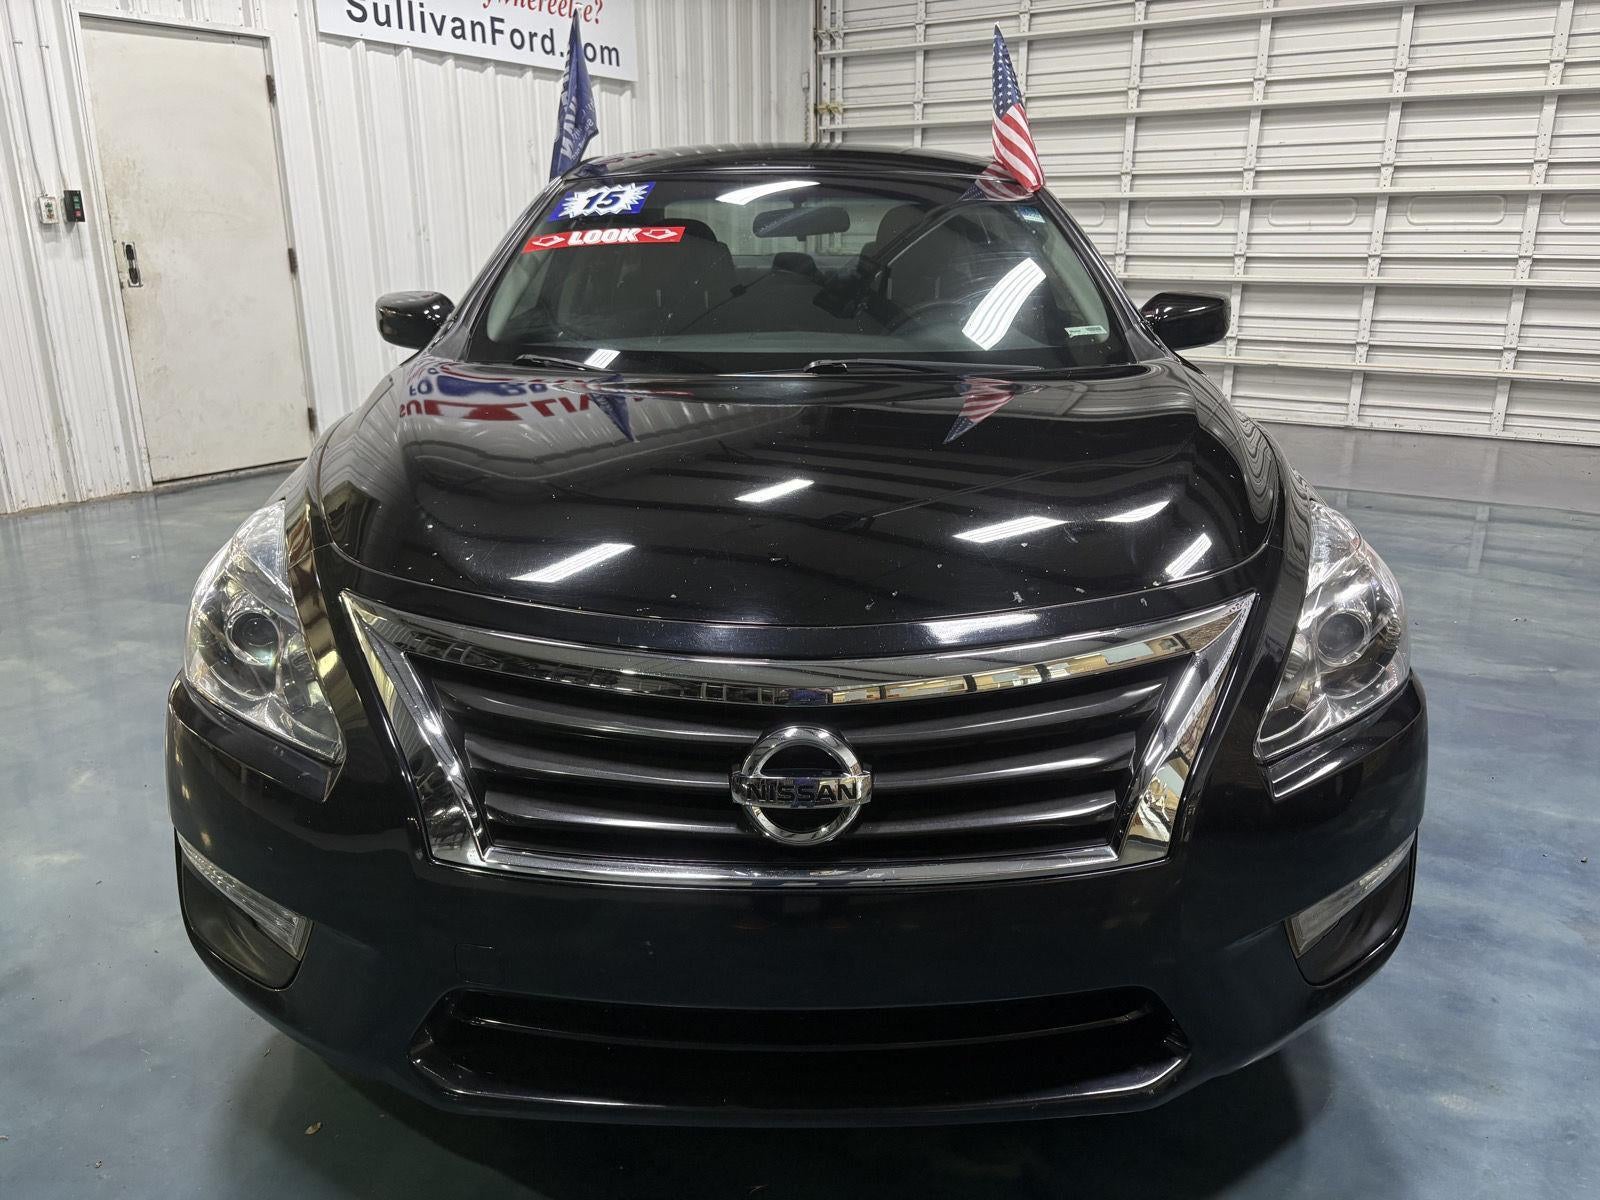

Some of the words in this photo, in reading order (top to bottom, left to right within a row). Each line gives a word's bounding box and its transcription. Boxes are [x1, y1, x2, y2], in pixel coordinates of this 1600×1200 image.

[345, 0, 621, 68] SullivanFord.om
[582, 189, 627, 211] 15
[567, 227, 643, 246] LOOK
[745, 782, 858, 802] NISSAN
